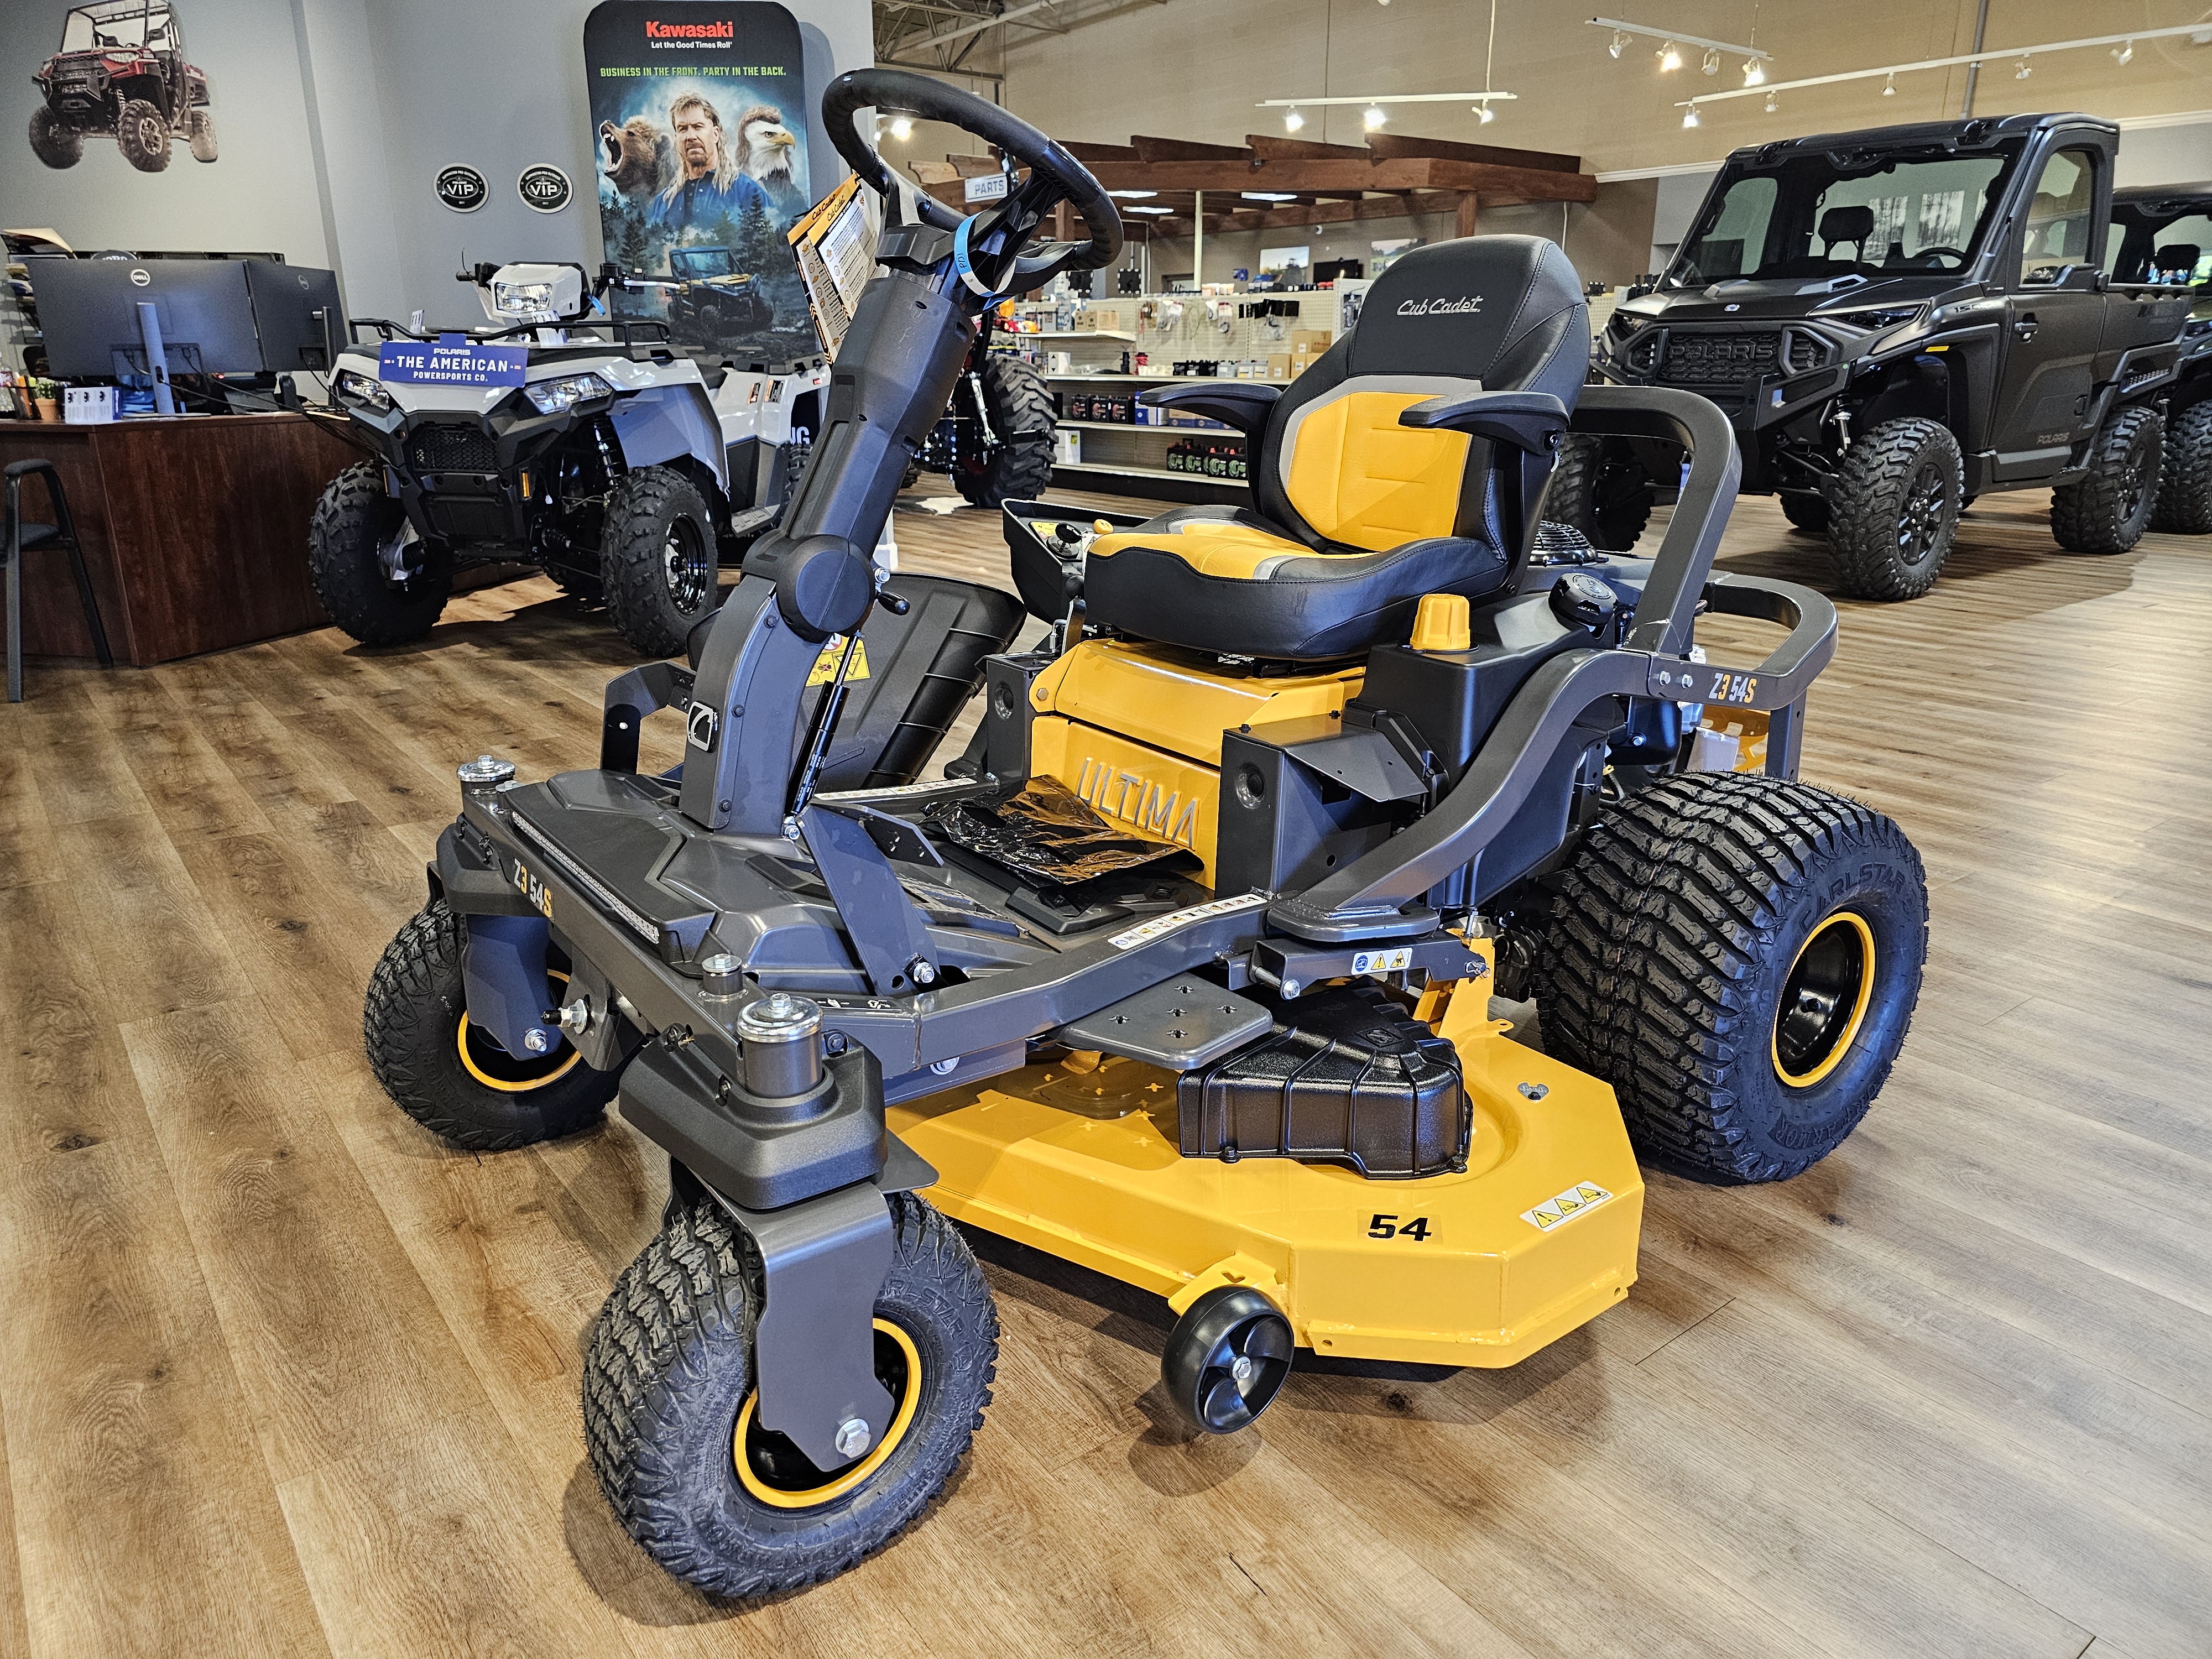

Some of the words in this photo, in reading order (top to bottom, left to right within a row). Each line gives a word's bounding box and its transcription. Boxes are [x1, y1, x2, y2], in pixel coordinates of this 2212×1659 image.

[646, 21, 733, 38] Kawasaki
[600, 67, 641, 77] BUSINESS
[643, 67, 651, 76] IN
[654, 67, 670, 76] THE
[672, 67, 701, 76] FRONT.
[703, 67, 730, 76] PARTY
[732, 67, 740, 76] IN
[743, 67, 759, 76] THE
[761, 66, 786, 76] BACK.
[446, 184, 474, 195] VIP
[530, 185, 557, 196] VIP
[975, 180, 1004, 195] PARTS
[812, 207, 822, 220] Cub
[821, 193, 836, 212] Cadet
[834, 195, 846, 212] Cadet
[1397, 299, 1428, 316] Cub
[1428, 295, 1483, 315] Cadet
[1668, 345, 1774, 359] POLARIS
[397, 356, 425, 368] THE
[430, 357, 508, 372] AMERICAN
[413, 371, 472, 381] POWERSPORTS
[2037, 432, 2070, 445] POLARIS
[1708, 672, 1730, 701] Z3
[1729, 676, 1757, 703] 54S
[1076, 757, 1201, 850] ULTIMA
[514, 858, 527, 894] Z3
[530, 875, 551, 918] 54S
[1800, 862, 1905, 933] CARLSTAR
[1368, 1214, 1432, 1241] 54
[885, 1277, 964, 1340] RLSTAR
